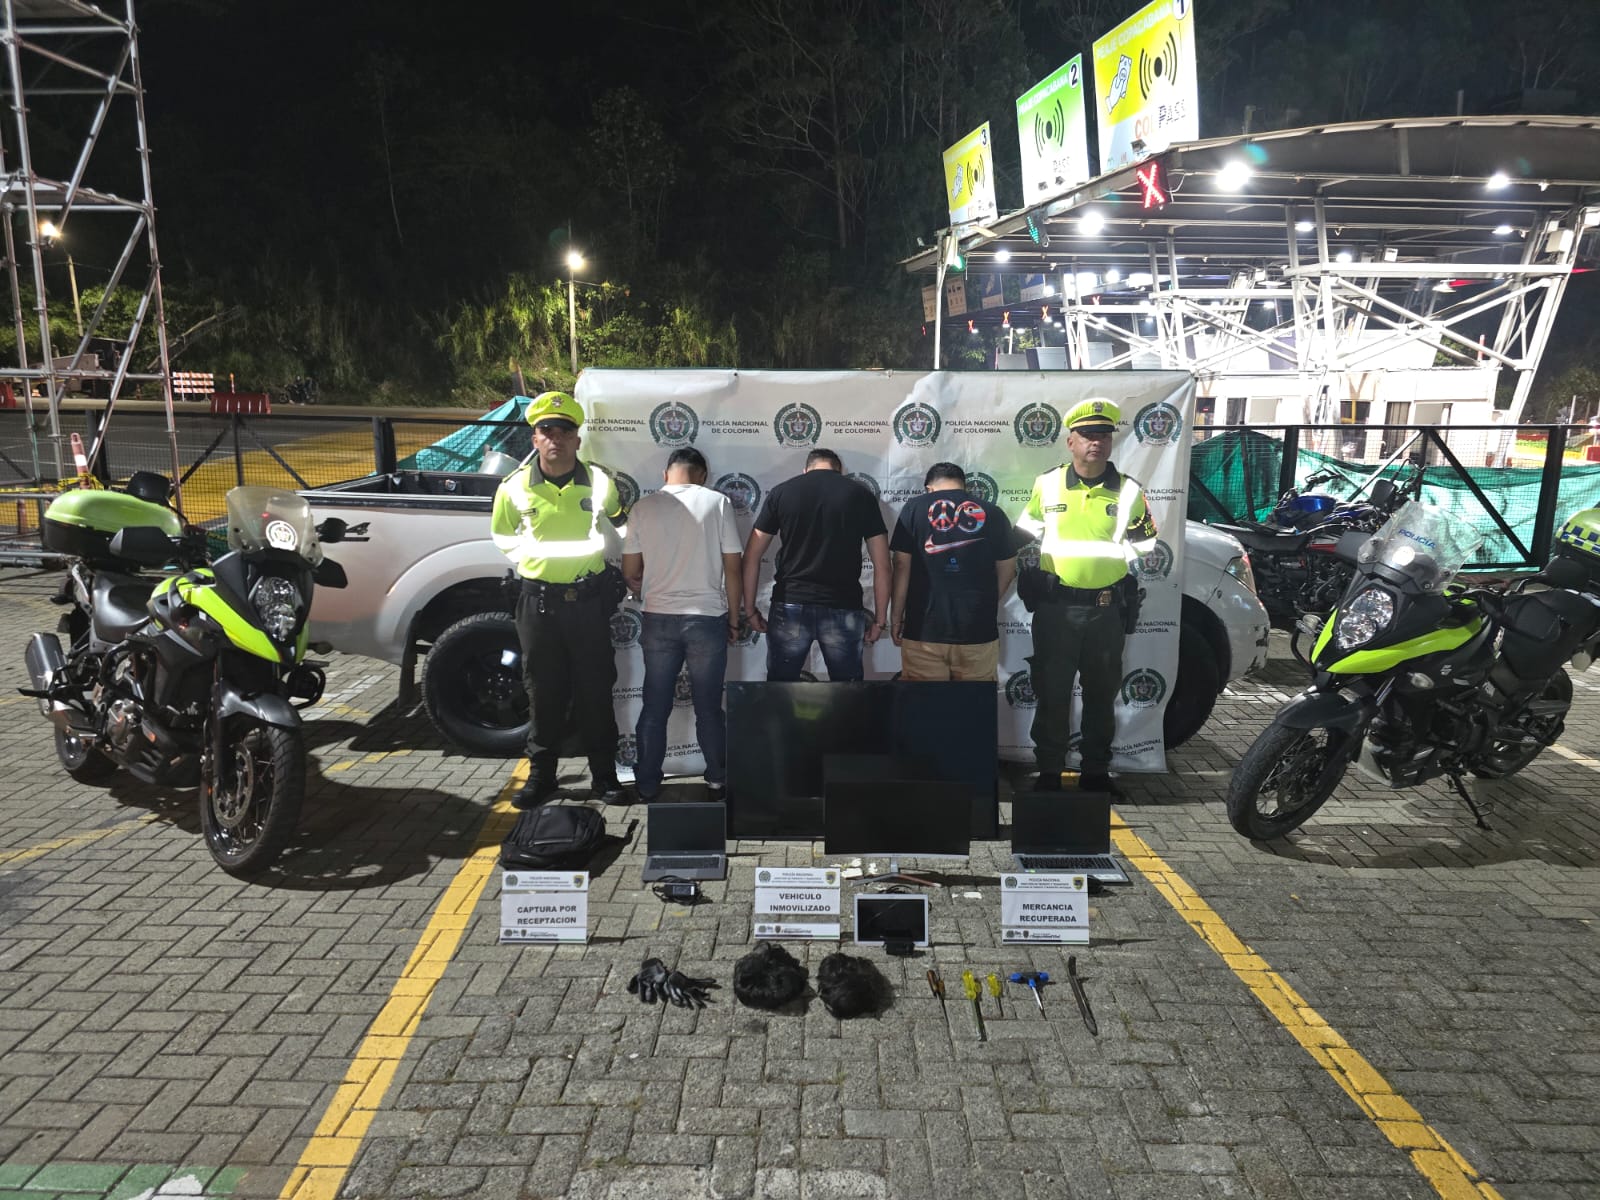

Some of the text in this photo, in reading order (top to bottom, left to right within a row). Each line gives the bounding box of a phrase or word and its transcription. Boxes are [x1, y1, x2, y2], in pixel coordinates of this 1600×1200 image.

[1070, 63, 1079, 86] 2
[981, 128, 988, 146] 3
[825, 419, 852, 427] POLICÍA
[1398, 528, 1436, 549] POLICÍA
[517, 905, 557, 914] CAPTURA
[770, 904, 831, 912] INMOVILIZADO
[1022, 903, 1073, 911] MERCANCIA
[517, 916, 577, 925] RECEPTACION
